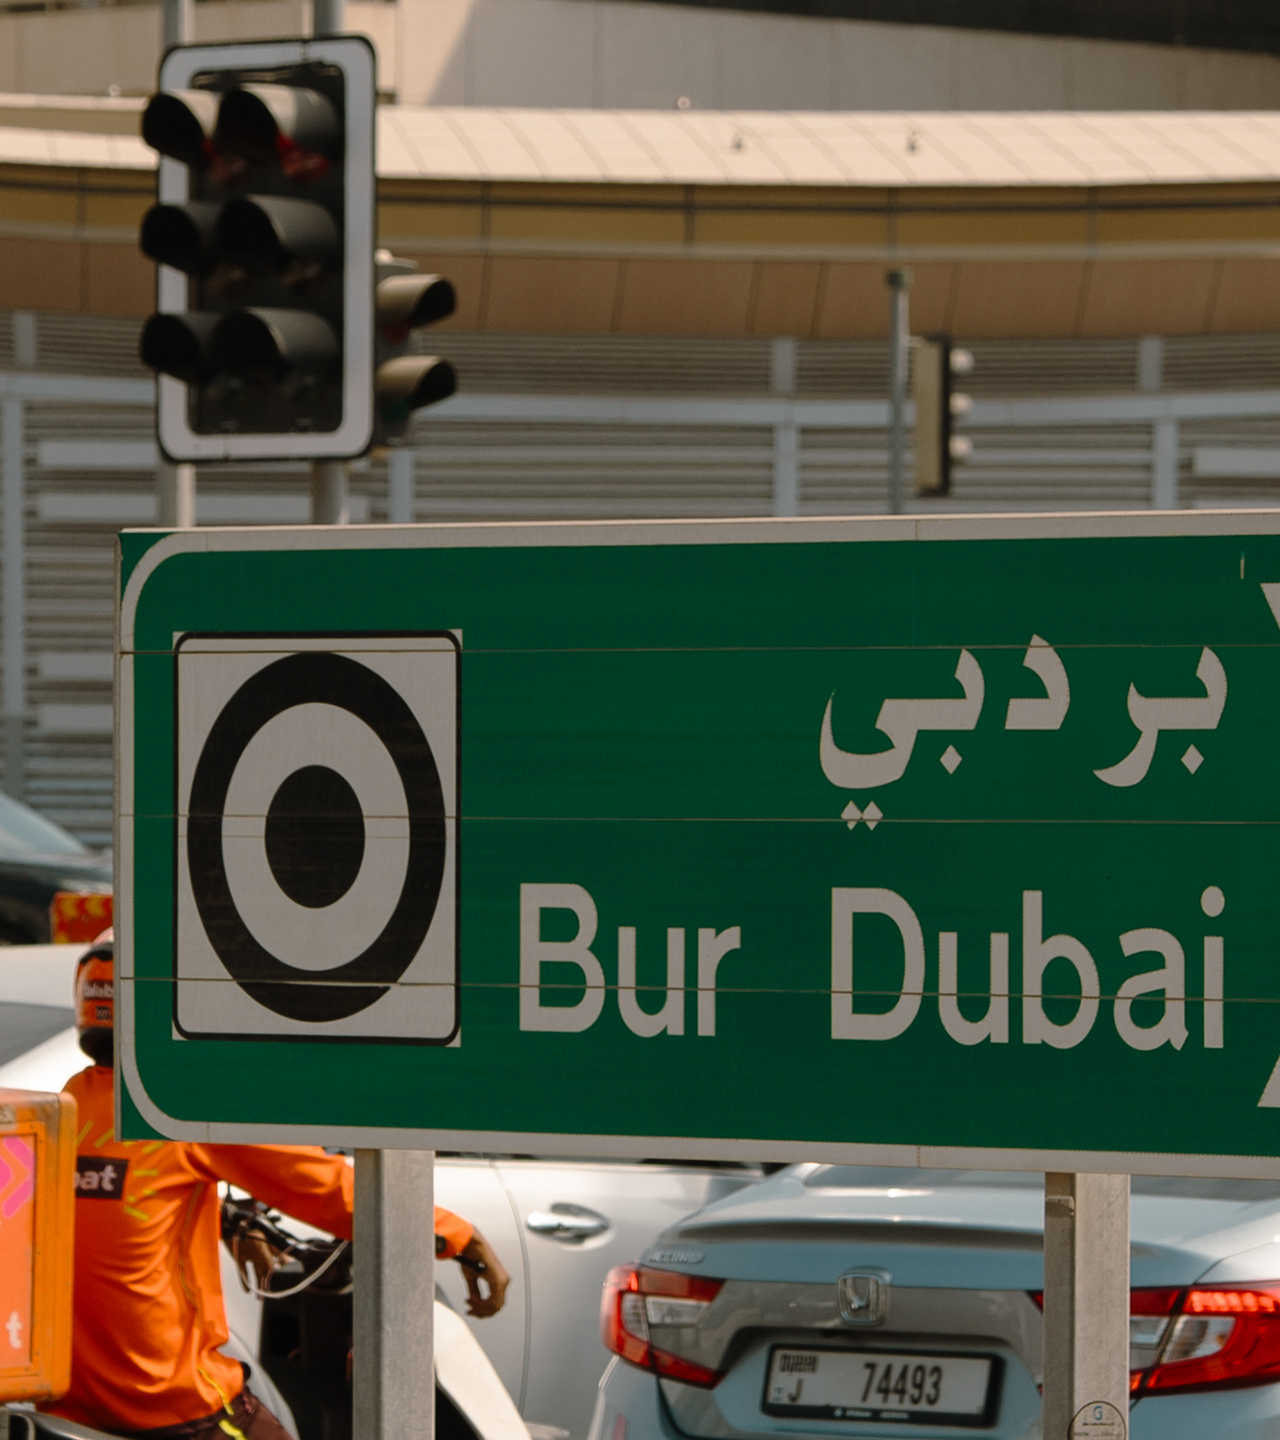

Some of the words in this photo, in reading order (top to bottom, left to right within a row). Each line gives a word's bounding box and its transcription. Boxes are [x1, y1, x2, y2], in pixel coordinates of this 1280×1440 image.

[819, 634, 1071, 831] دبي
[1093, 645, 1228, 787] بر
[519, 882, 741, 1038] Bur
[830, 885, 1226, 1051] Dubai
[787, 1378, 805, 1404] J
[861, 1361, 943, 1407] 74493
